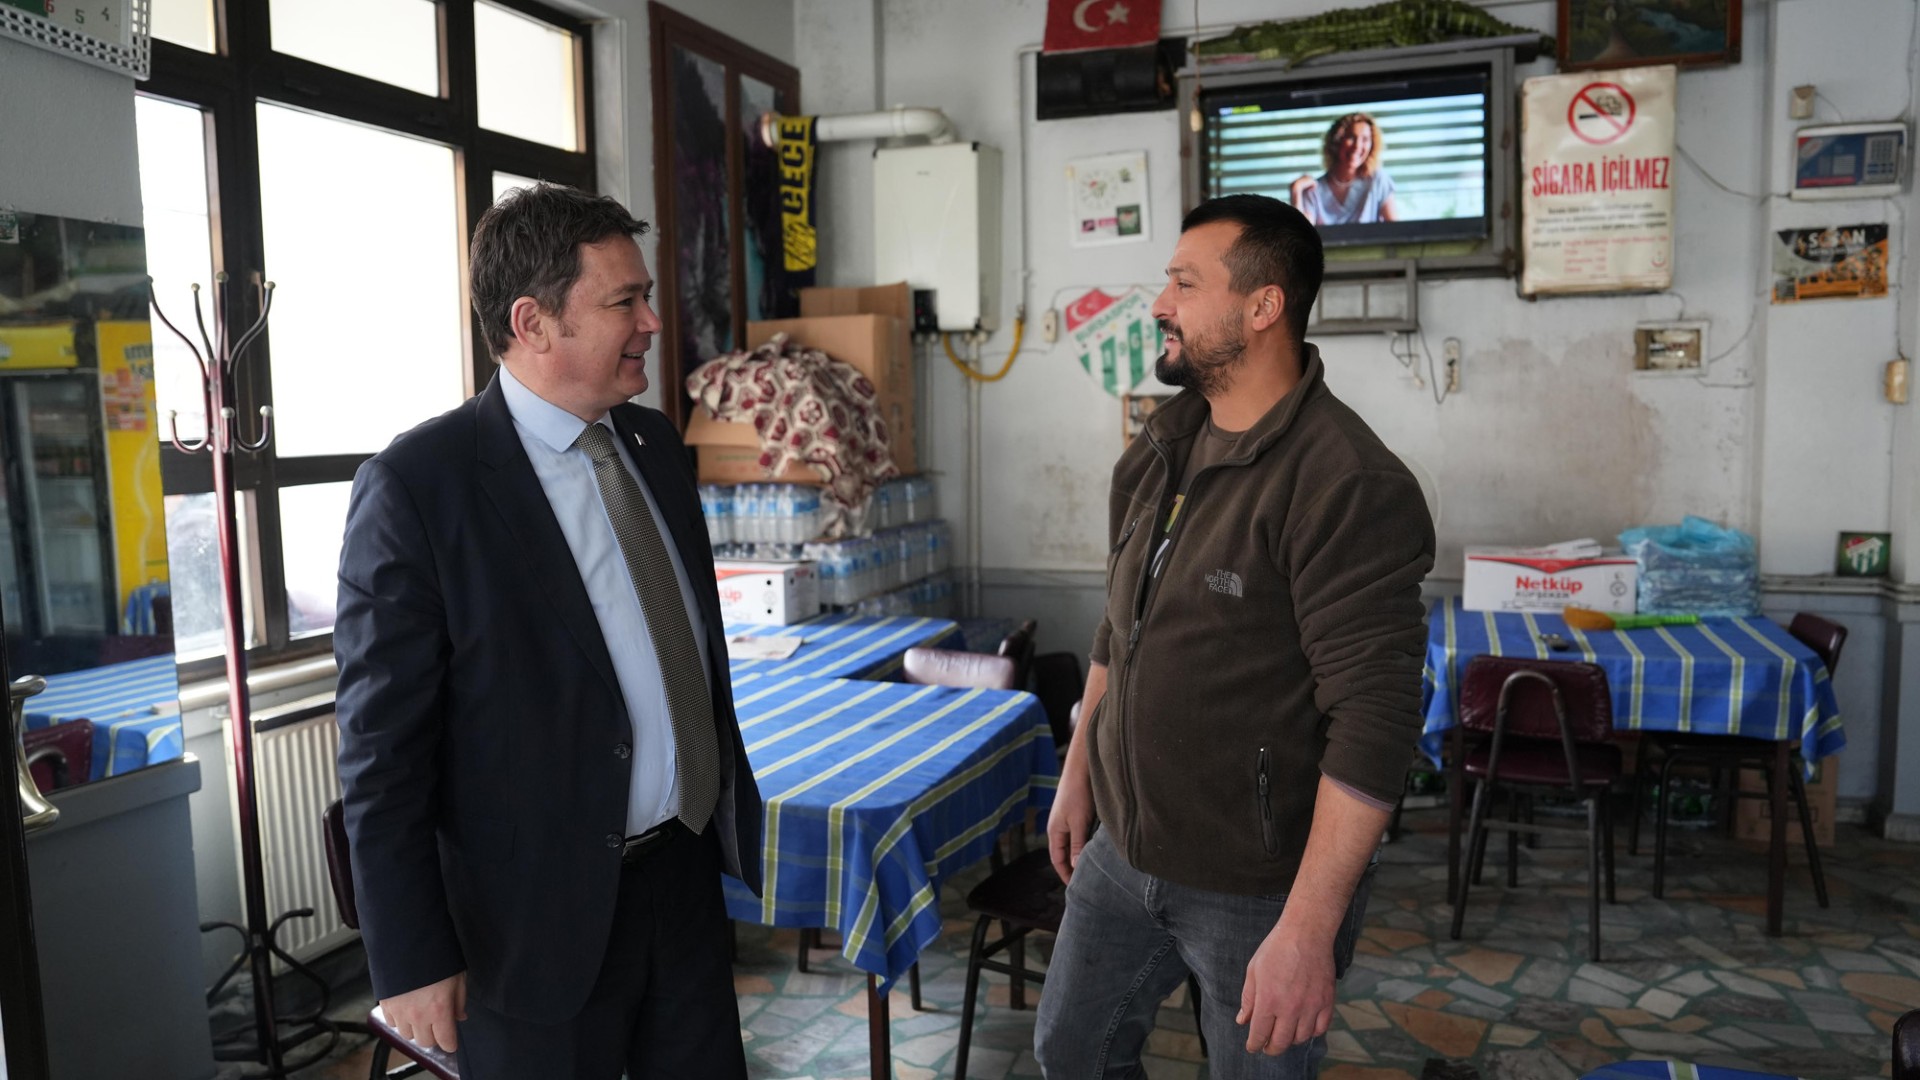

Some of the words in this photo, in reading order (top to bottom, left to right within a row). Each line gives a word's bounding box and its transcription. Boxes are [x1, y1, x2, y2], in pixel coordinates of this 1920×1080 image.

[75, 9, 85, 24] 5
[1532, 161, 1596, 197] SİGARA
[1602, 154, 1670, 196] İÇİLMEZ
[1204, 573, 1231, 587] NORTH
[1216, 569, 1232, 580] THE
[1209, 582, 1230, 594] FACE
[1515, 575, 1583, 595] Netküp
